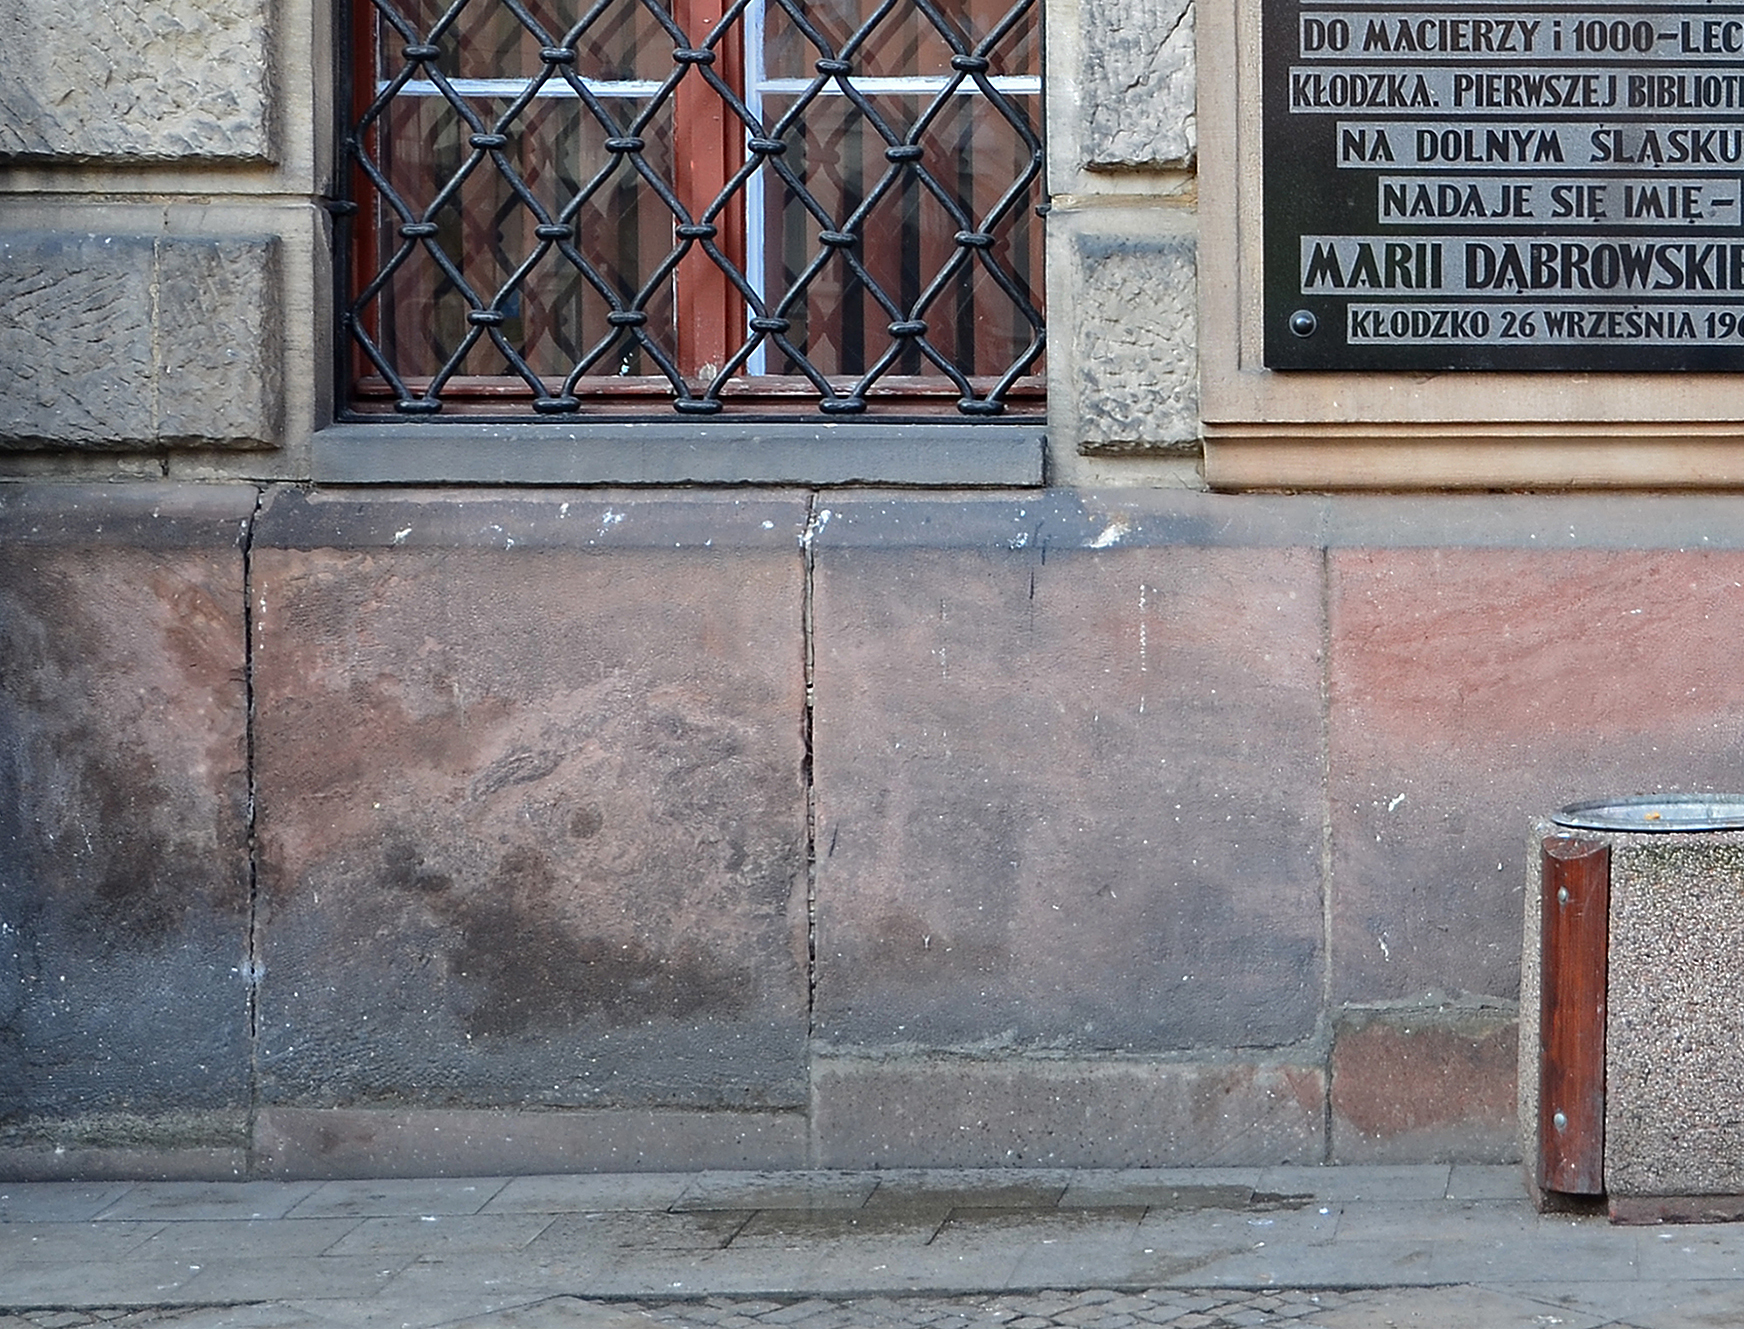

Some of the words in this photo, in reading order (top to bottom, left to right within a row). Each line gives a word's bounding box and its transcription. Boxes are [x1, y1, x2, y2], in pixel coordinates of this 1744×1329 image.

[1304, 18, 1350, 52] DO
[1362, 19, 1540, 52] MACIERZY
[1454, 74, 1618, 108] PIERWSZEJ
[1342, 130, 1394, 162] NA
[1416, 130, 1564, 163] DOLNYM
[1591, 123, 1742, 167] ŚLĄSKU
[1383, 184, 1532, 218] NADAJE
[1551, 184, 1606, 222] SIĘ
[1304, 243, 1441, 289] MARII
[1351, 311, 1490, 338] KŁODZKO
[1500, 311, 1535, 338] 26
[1548, 306, 1696, 338] WRZEŚNIA
